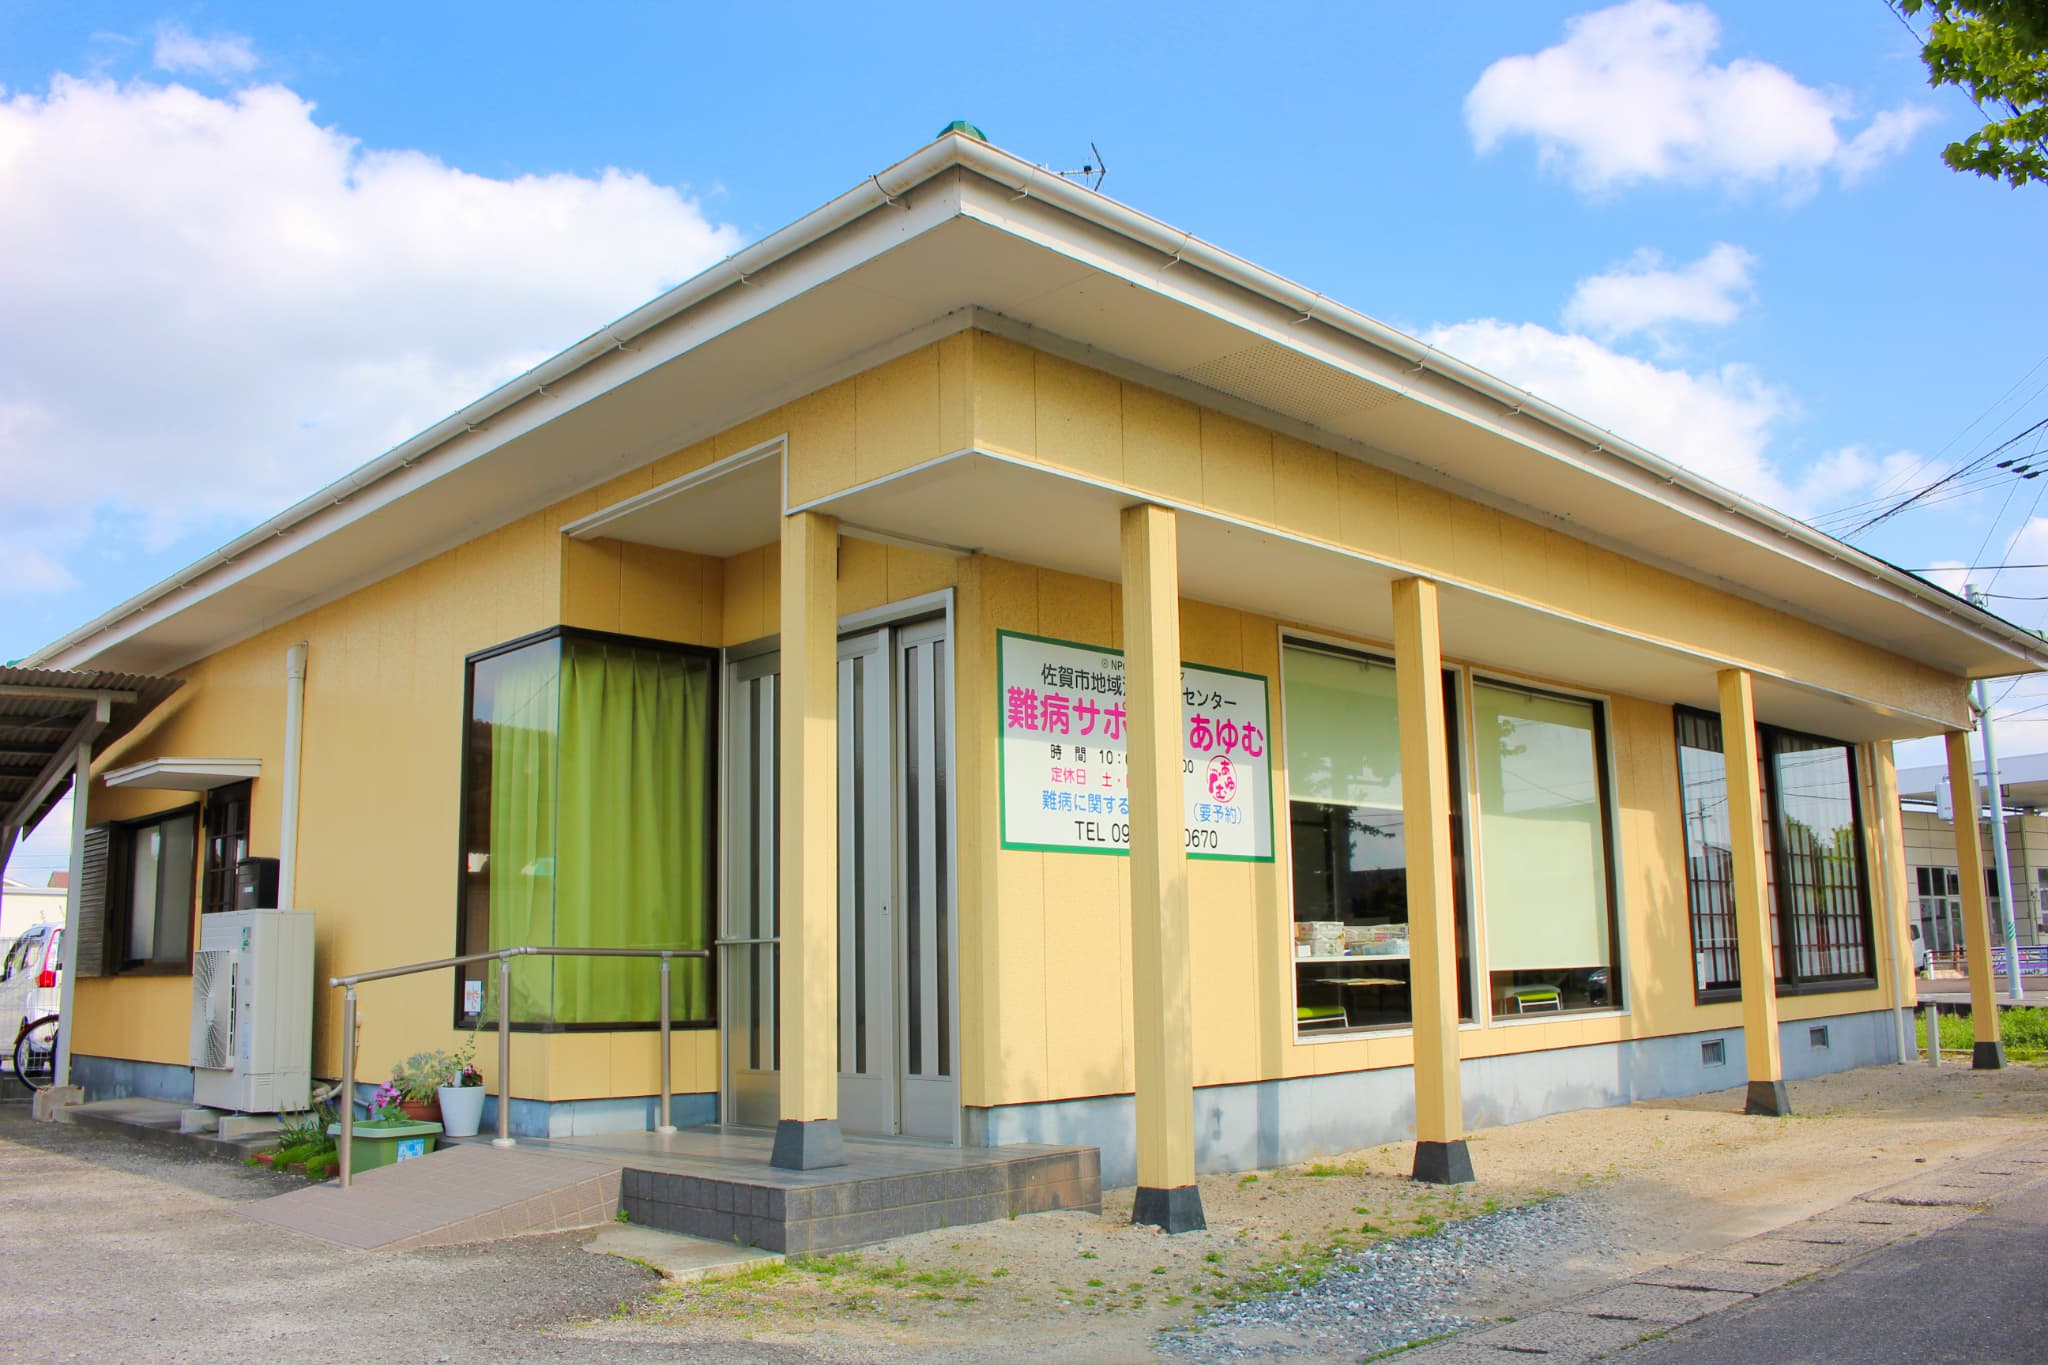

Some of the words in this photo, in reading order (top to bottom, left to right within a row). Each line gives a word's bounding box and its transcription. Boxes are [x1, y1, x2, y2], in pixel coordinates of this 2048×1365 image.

[1182, 687, 1237, 710] センター
[1189, 713, 1264, 758] あゆむ
[1051, 766, 1086, 785] 定休日
[1042, 790, 1129, 815] 難病に関する
[1074, 820, 1106, 841] TEL
